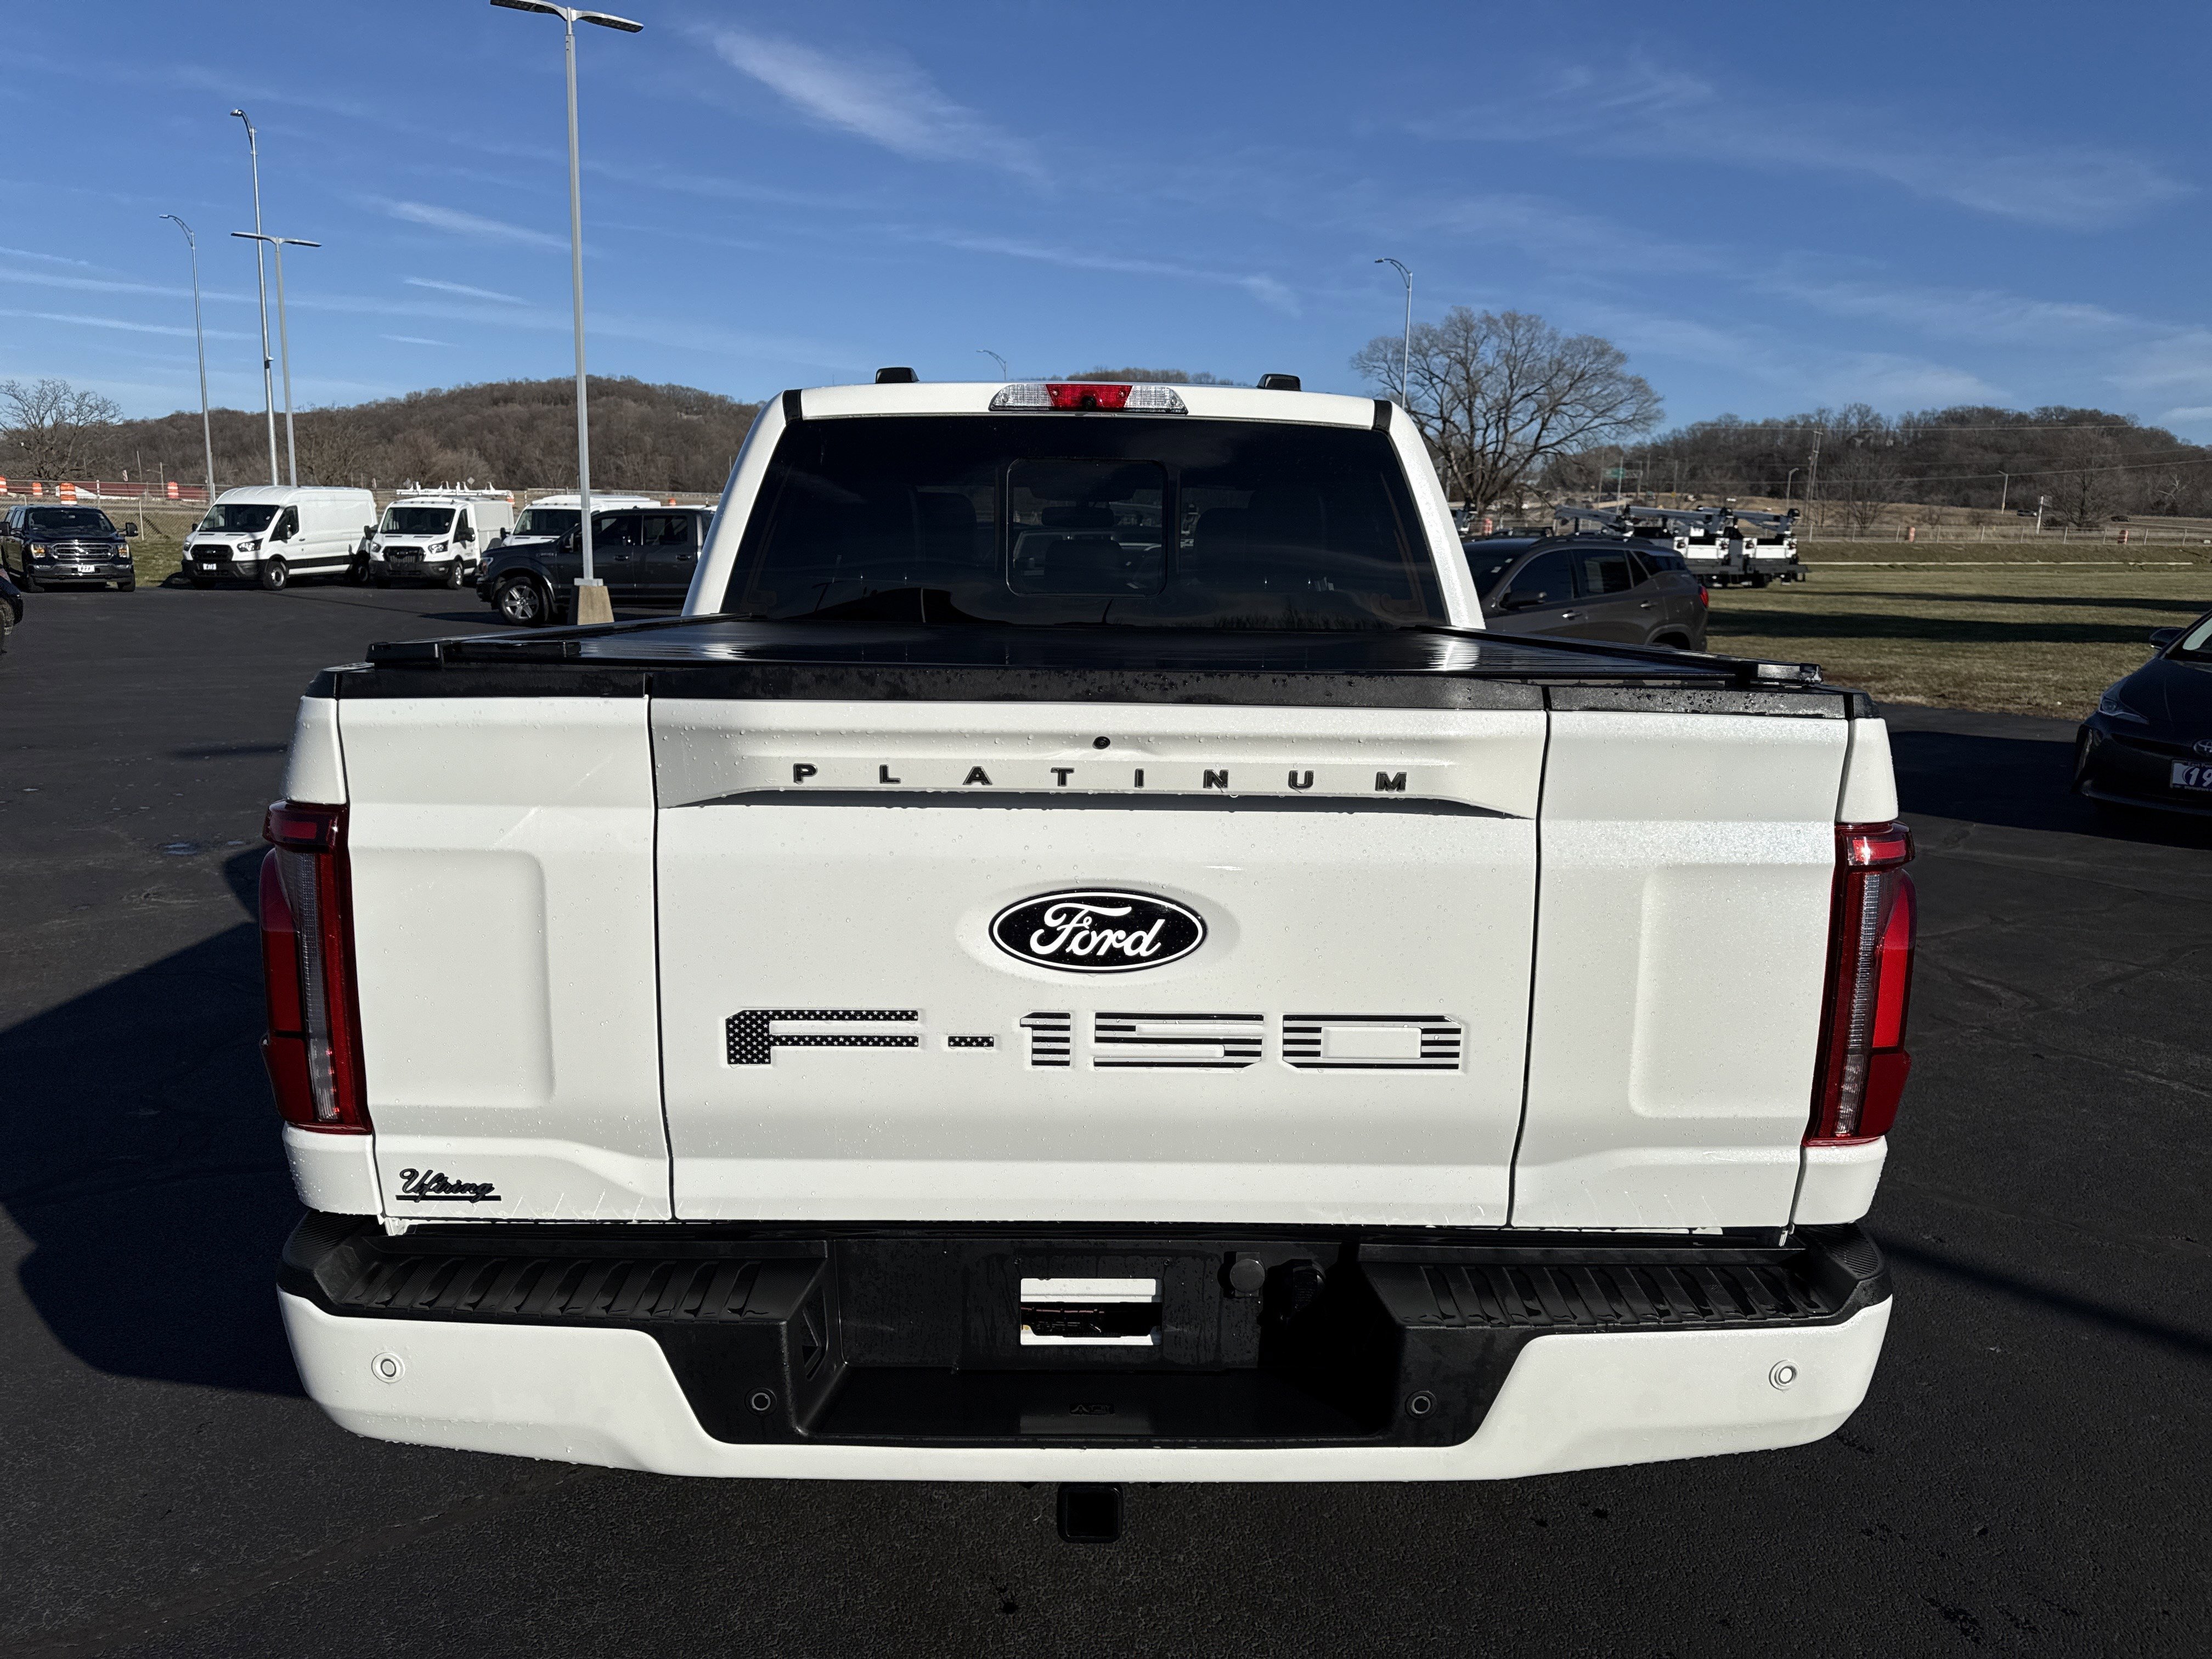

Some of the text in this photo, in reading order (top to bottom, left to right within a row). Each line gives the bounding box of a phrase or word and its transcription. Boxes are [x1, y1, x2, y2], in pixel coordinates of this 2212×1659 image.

[792, 763, 1407, 792] PLATINUM
[1030, 902, 1165, 957] Ford
[725, 1009, 1462, 1071] F-150
